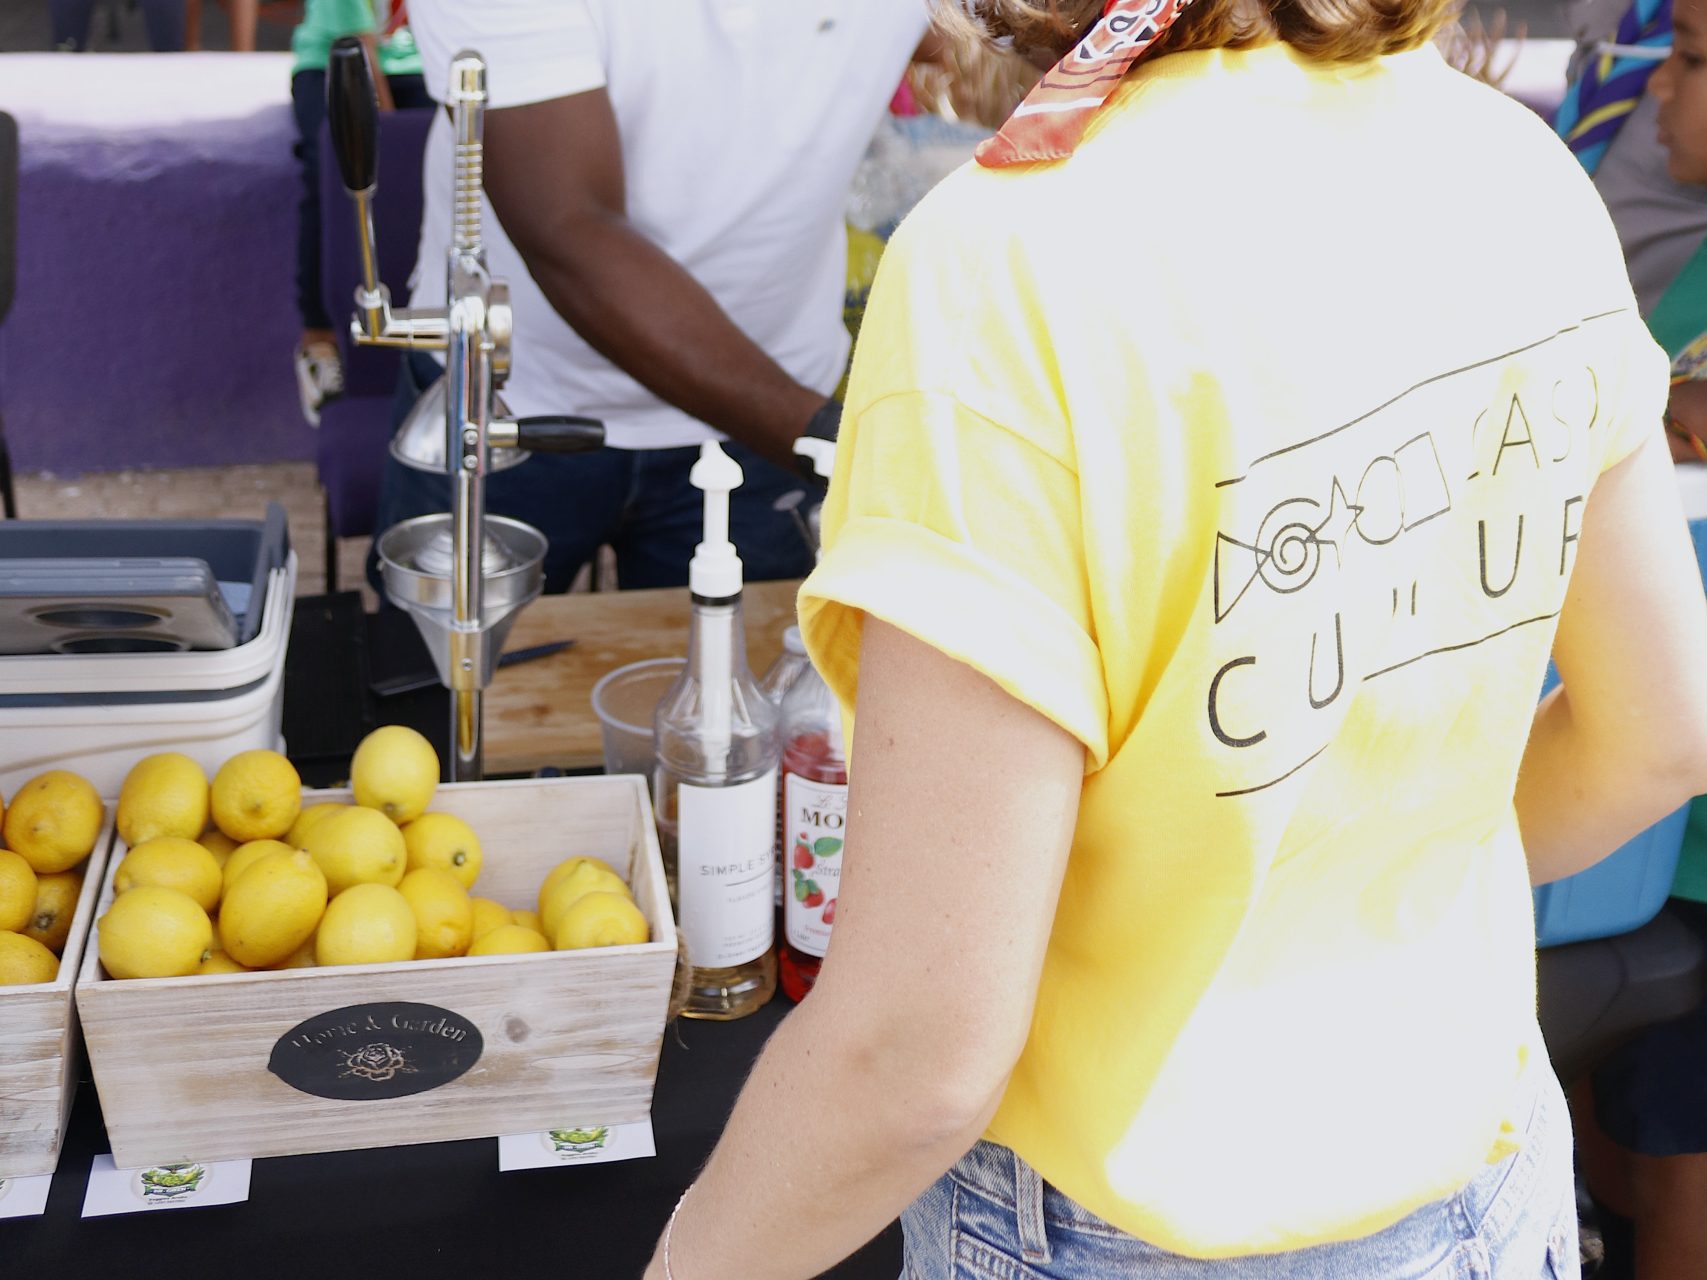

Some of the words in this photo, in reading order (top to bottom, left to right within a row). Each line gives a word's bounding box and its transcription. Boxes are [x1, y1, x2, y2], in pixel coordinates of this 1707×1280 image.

[700, 858, 756, 876] SIMPLE
[365, 1015, 382, 1032] &
[391, 1014, 468, 1043] Garden
